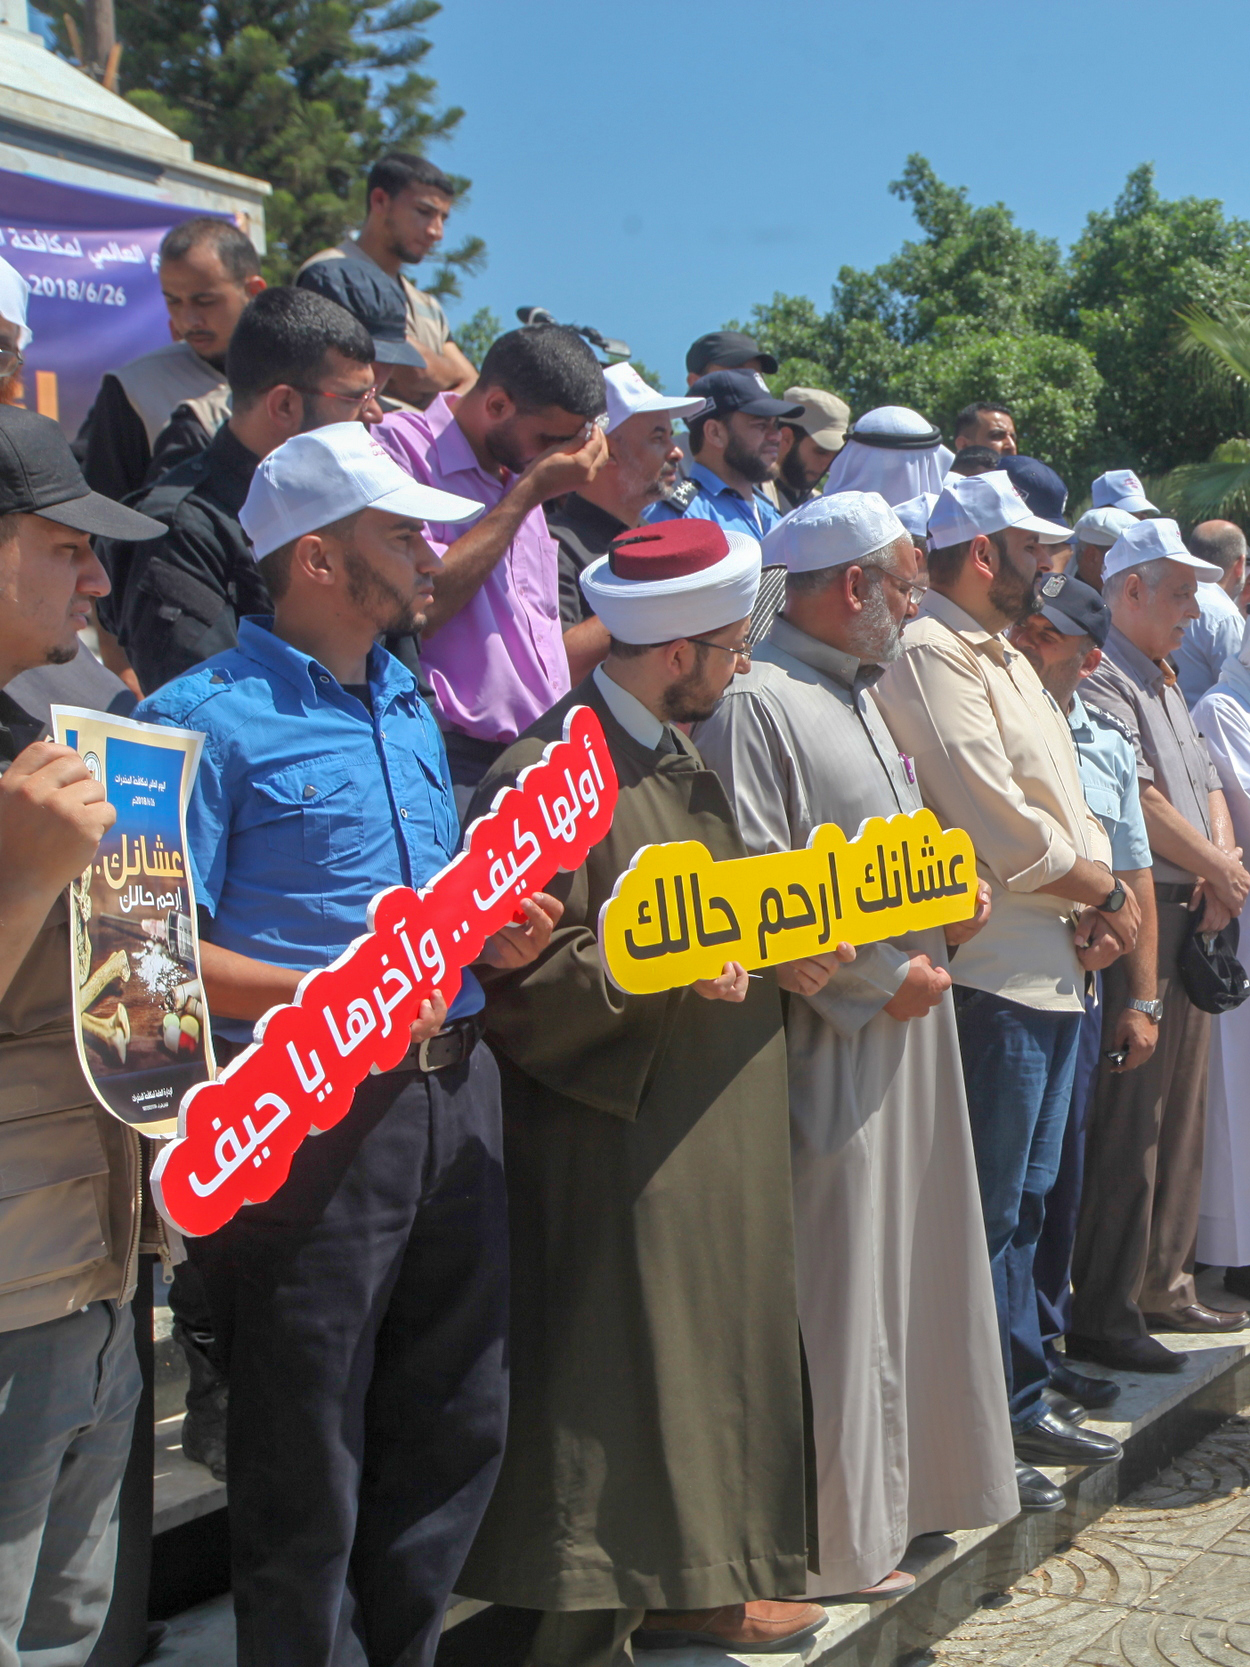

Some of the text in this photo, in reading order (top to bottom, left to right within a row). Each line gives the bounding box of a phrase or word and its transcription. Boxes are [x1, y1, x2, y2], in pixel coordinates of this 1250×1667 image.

[8, 227, 84, 258] لمكافحة
[88, 241, 147, 270] العالمي
[25, 274, 127, 307] 2018/6/26
[538, 733, 605, 843] أولها
[119, 885, 155, 913] حالك
[473, 819, 542, 912] كيف
[624, 835, 968, 960] عشانك ارحم حالك
[323, 917, 446, 1058] وآخرها
[285, 1040, 334, 1103] يا
[188, 1092, 291, 1198] حيف
